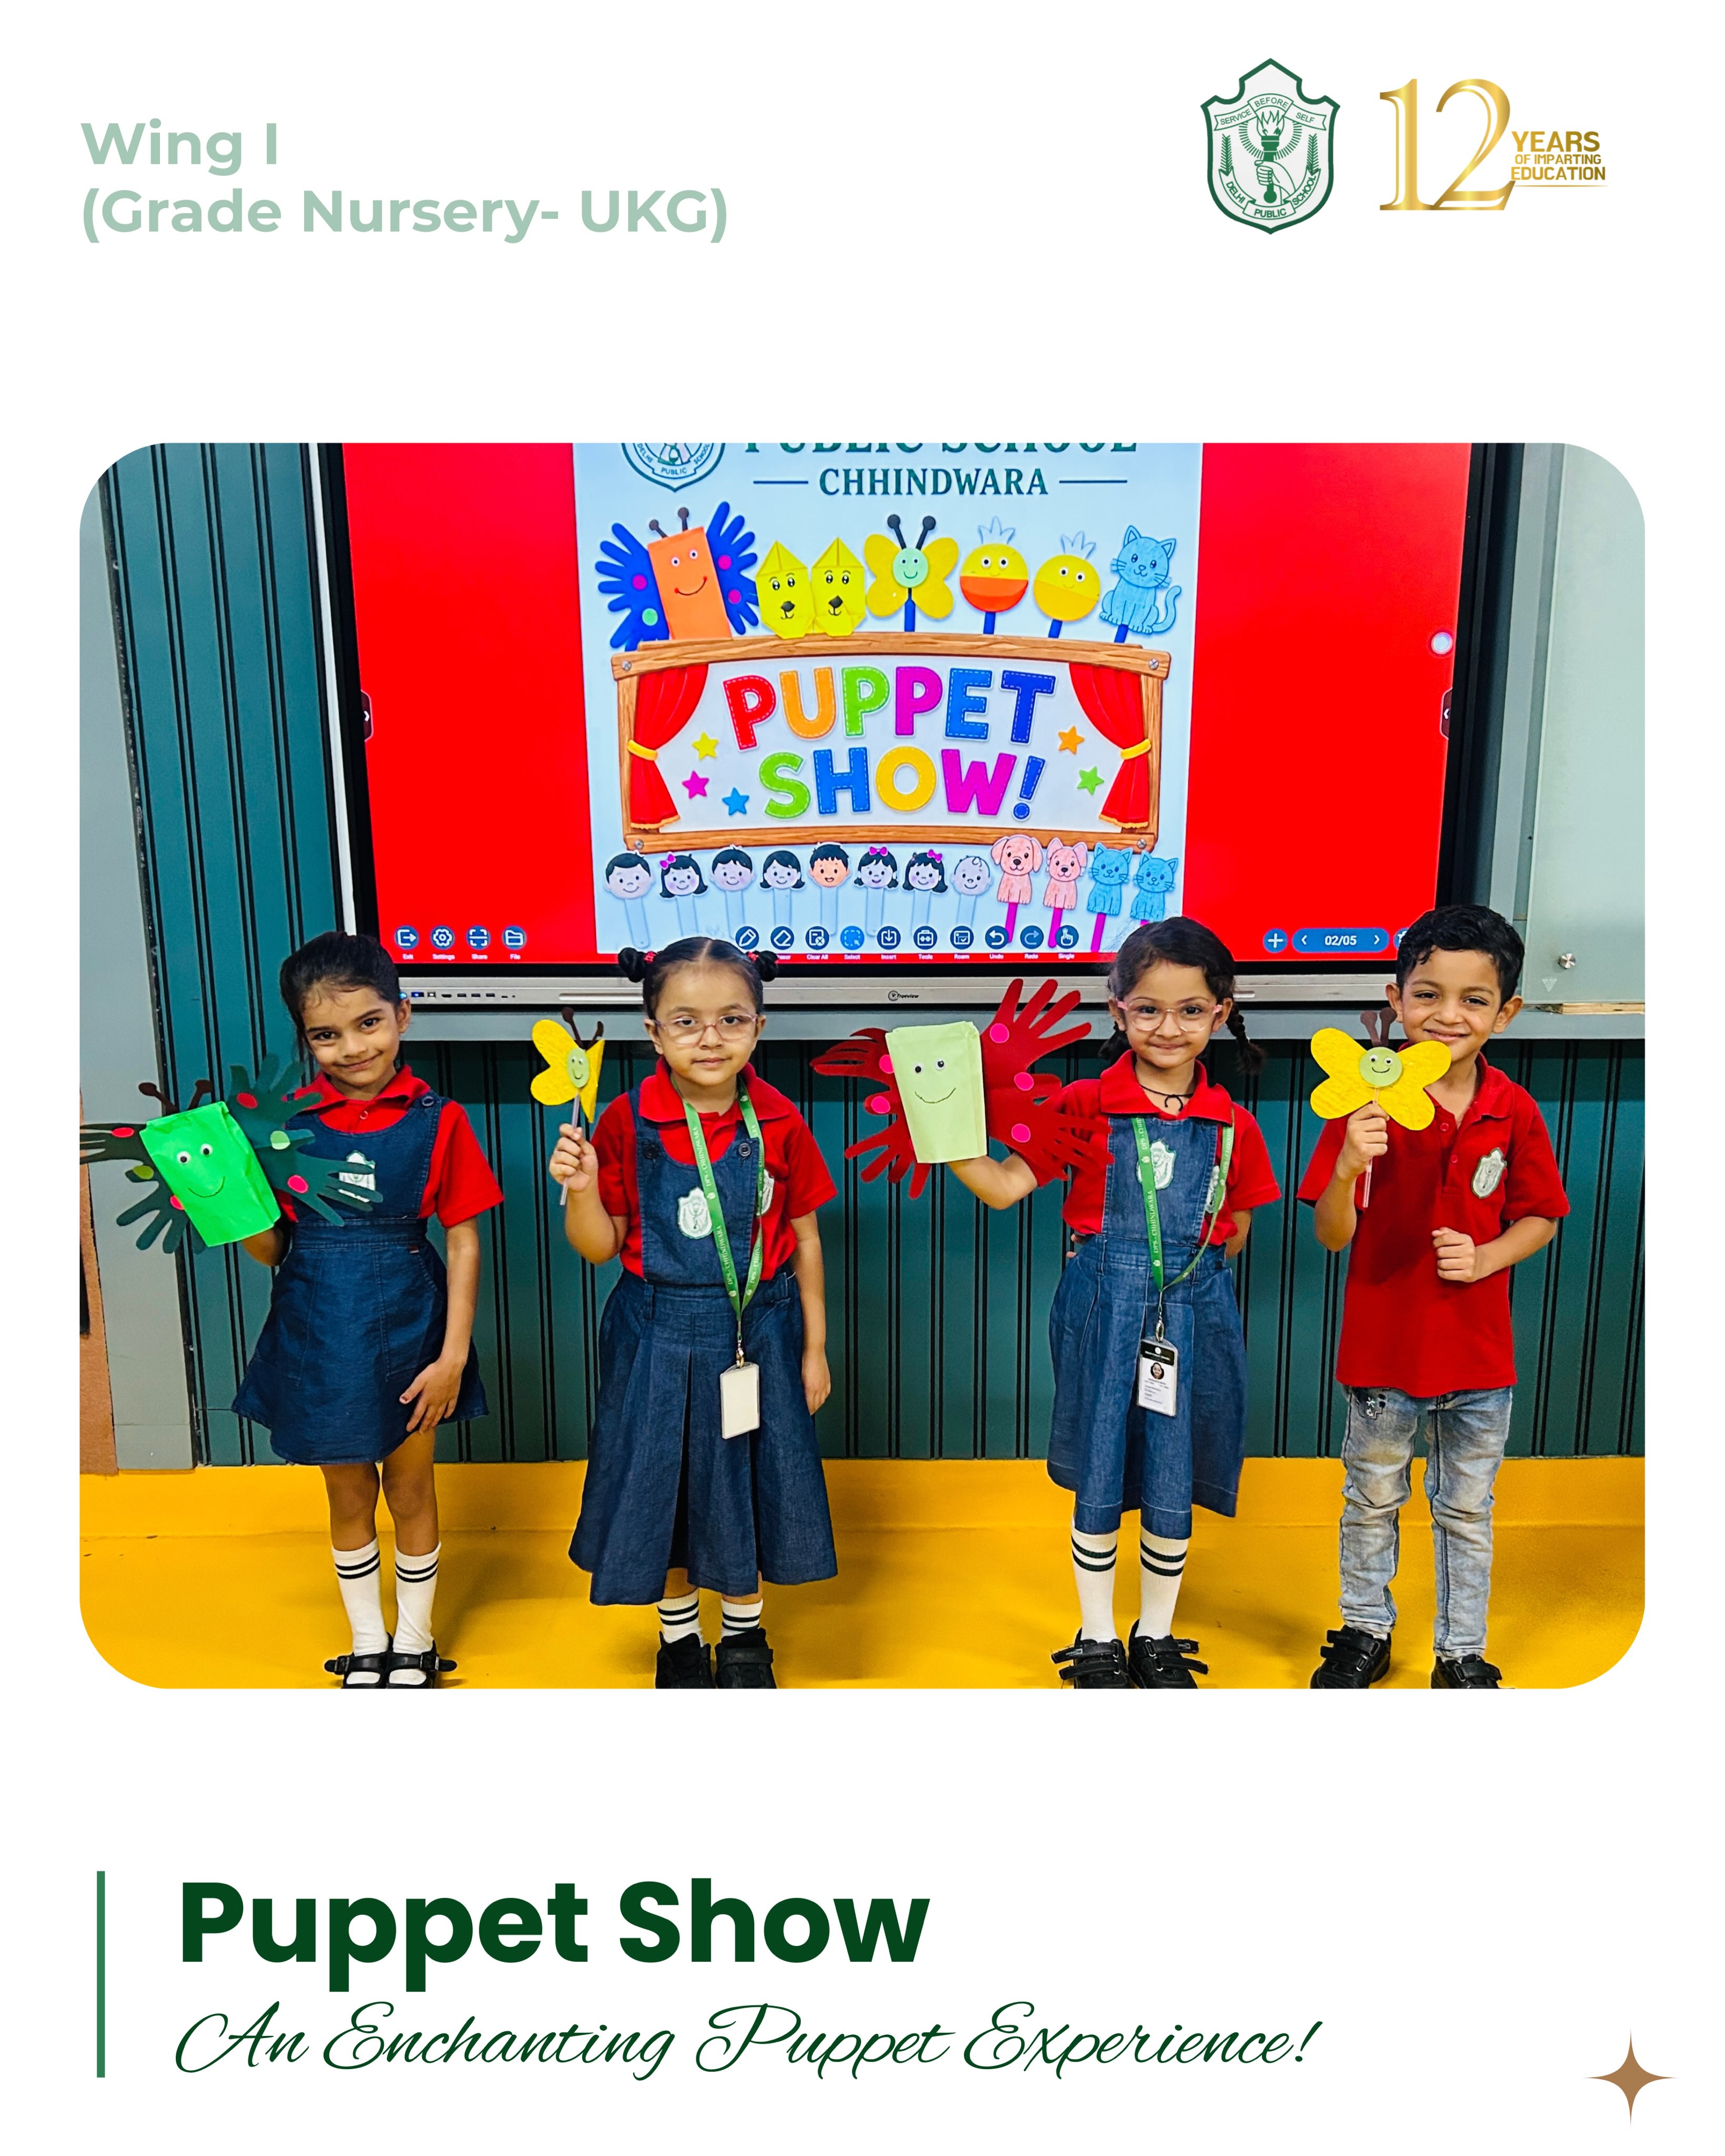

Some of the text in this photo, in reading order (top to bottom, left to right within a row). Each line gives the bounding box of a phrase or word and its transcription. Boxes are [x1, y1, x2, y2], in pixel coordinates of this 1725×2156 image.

[637, 443, 653, 463] DELHI
[693, 443, 710, 464] SCHOOL
[819, 468, 1049, 496] CHHINDWARA
[723, 666, 1056, 751] PUPPET
[759, 746, 1046, 821] SHOW!
[1324, 935, 1357, 946] 02/05
[1148, 1190, 1157, 1236] CHHINDWARA
